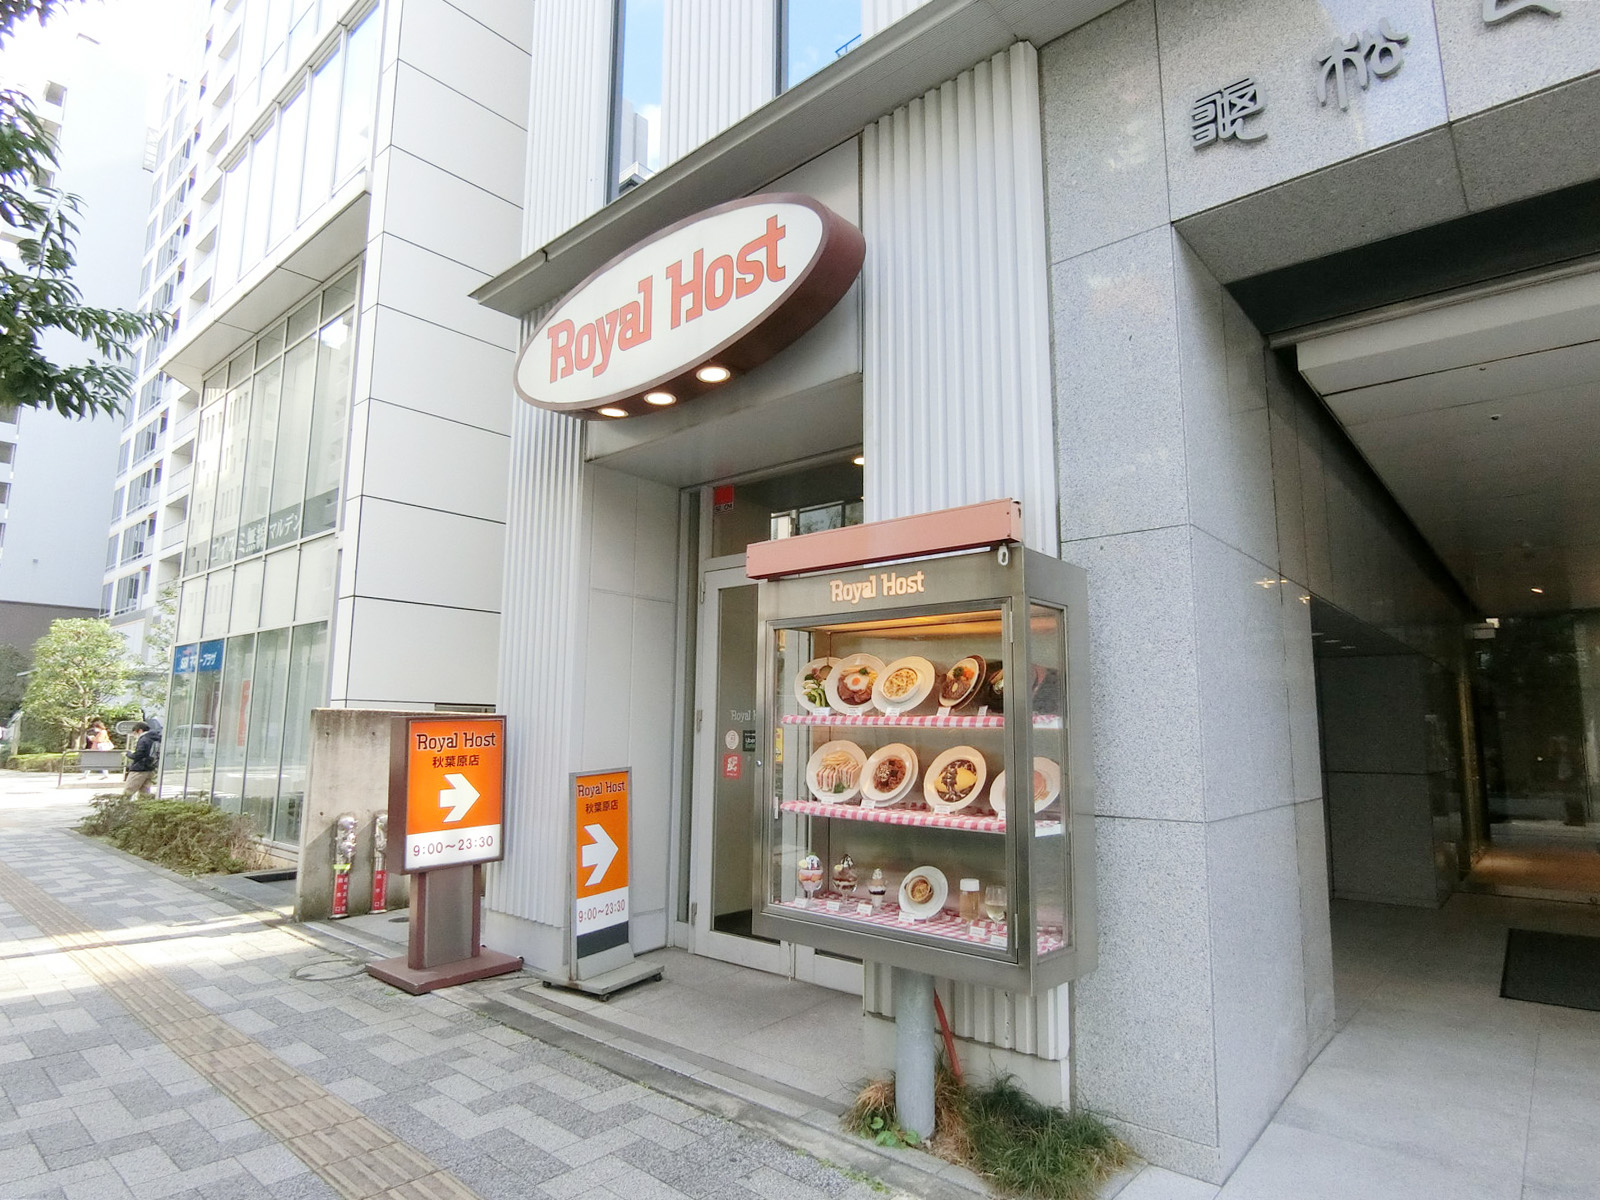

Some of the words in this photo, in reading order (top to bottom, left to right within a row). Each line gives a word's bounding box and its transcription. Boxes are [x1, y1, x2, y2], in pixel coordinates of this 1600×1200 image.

[547, 275, 654, 384] Royal
[665, 214, 787, 331] Host
[829, 574, 877, 604] Royal
[880, 570, 925, 596] Host
[731, 709, 751, 723] Royal
[416, 732, 459, 753] Royal
[462, 731, 497, 748] Host
[432, 755, 480, 769] 秋葉原店
[576, 782, 603, 798] Royal
[605, 780, 626, 793] Host
[585, 800, 619, 815] 秋葉原店
[413, 835, 494, 857] 9:00～23:30
[578, 899, 626, 923] 9:00～23:30
